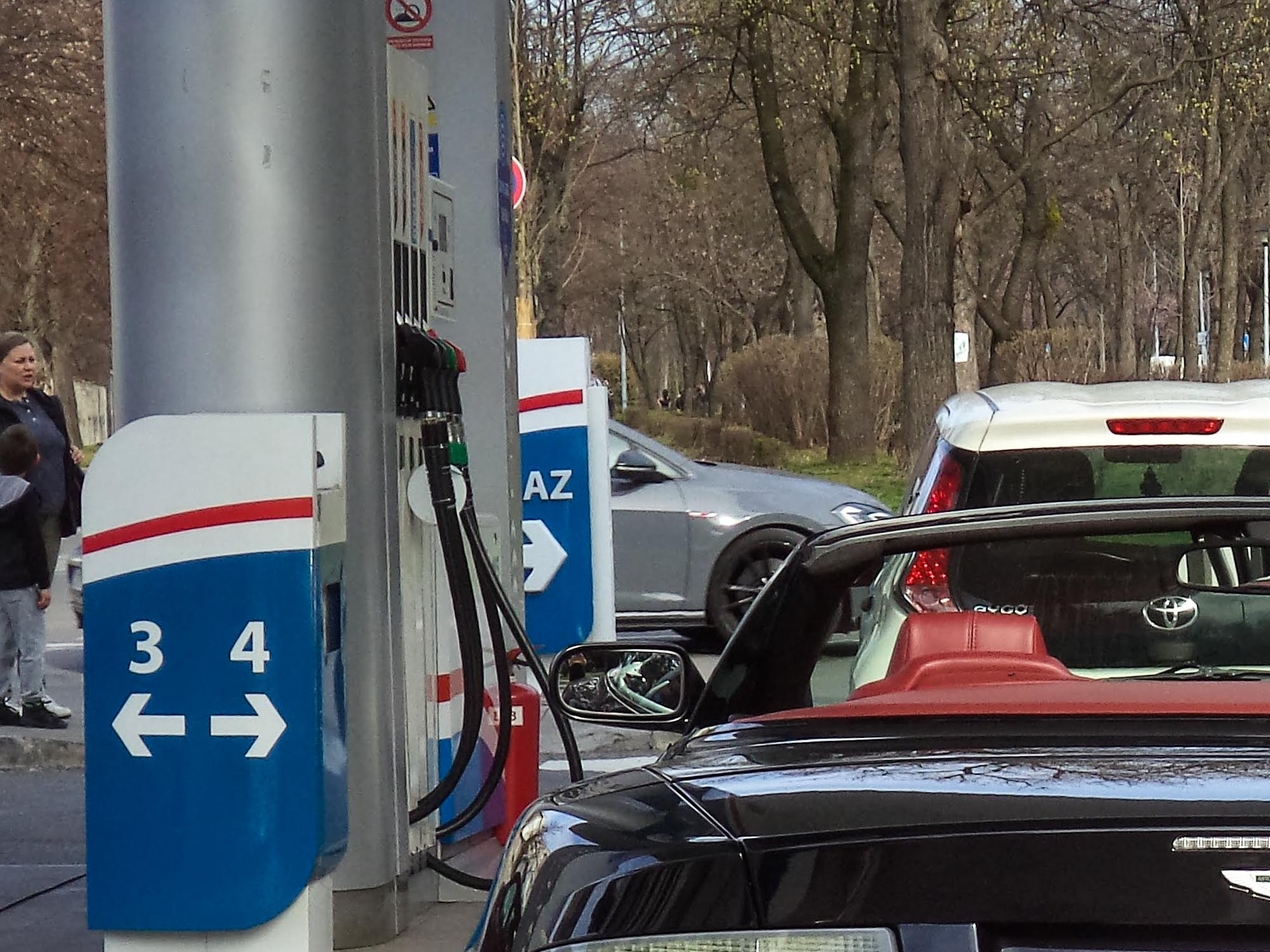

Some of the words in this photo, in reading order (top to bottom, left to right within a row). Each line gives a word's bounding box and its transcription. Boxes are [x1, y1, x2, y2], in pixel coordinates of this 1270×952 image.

[523, 469, 573, 500] AZ
[129, 620, 164, 674] 3
[230, 621, 270, 673] 4
